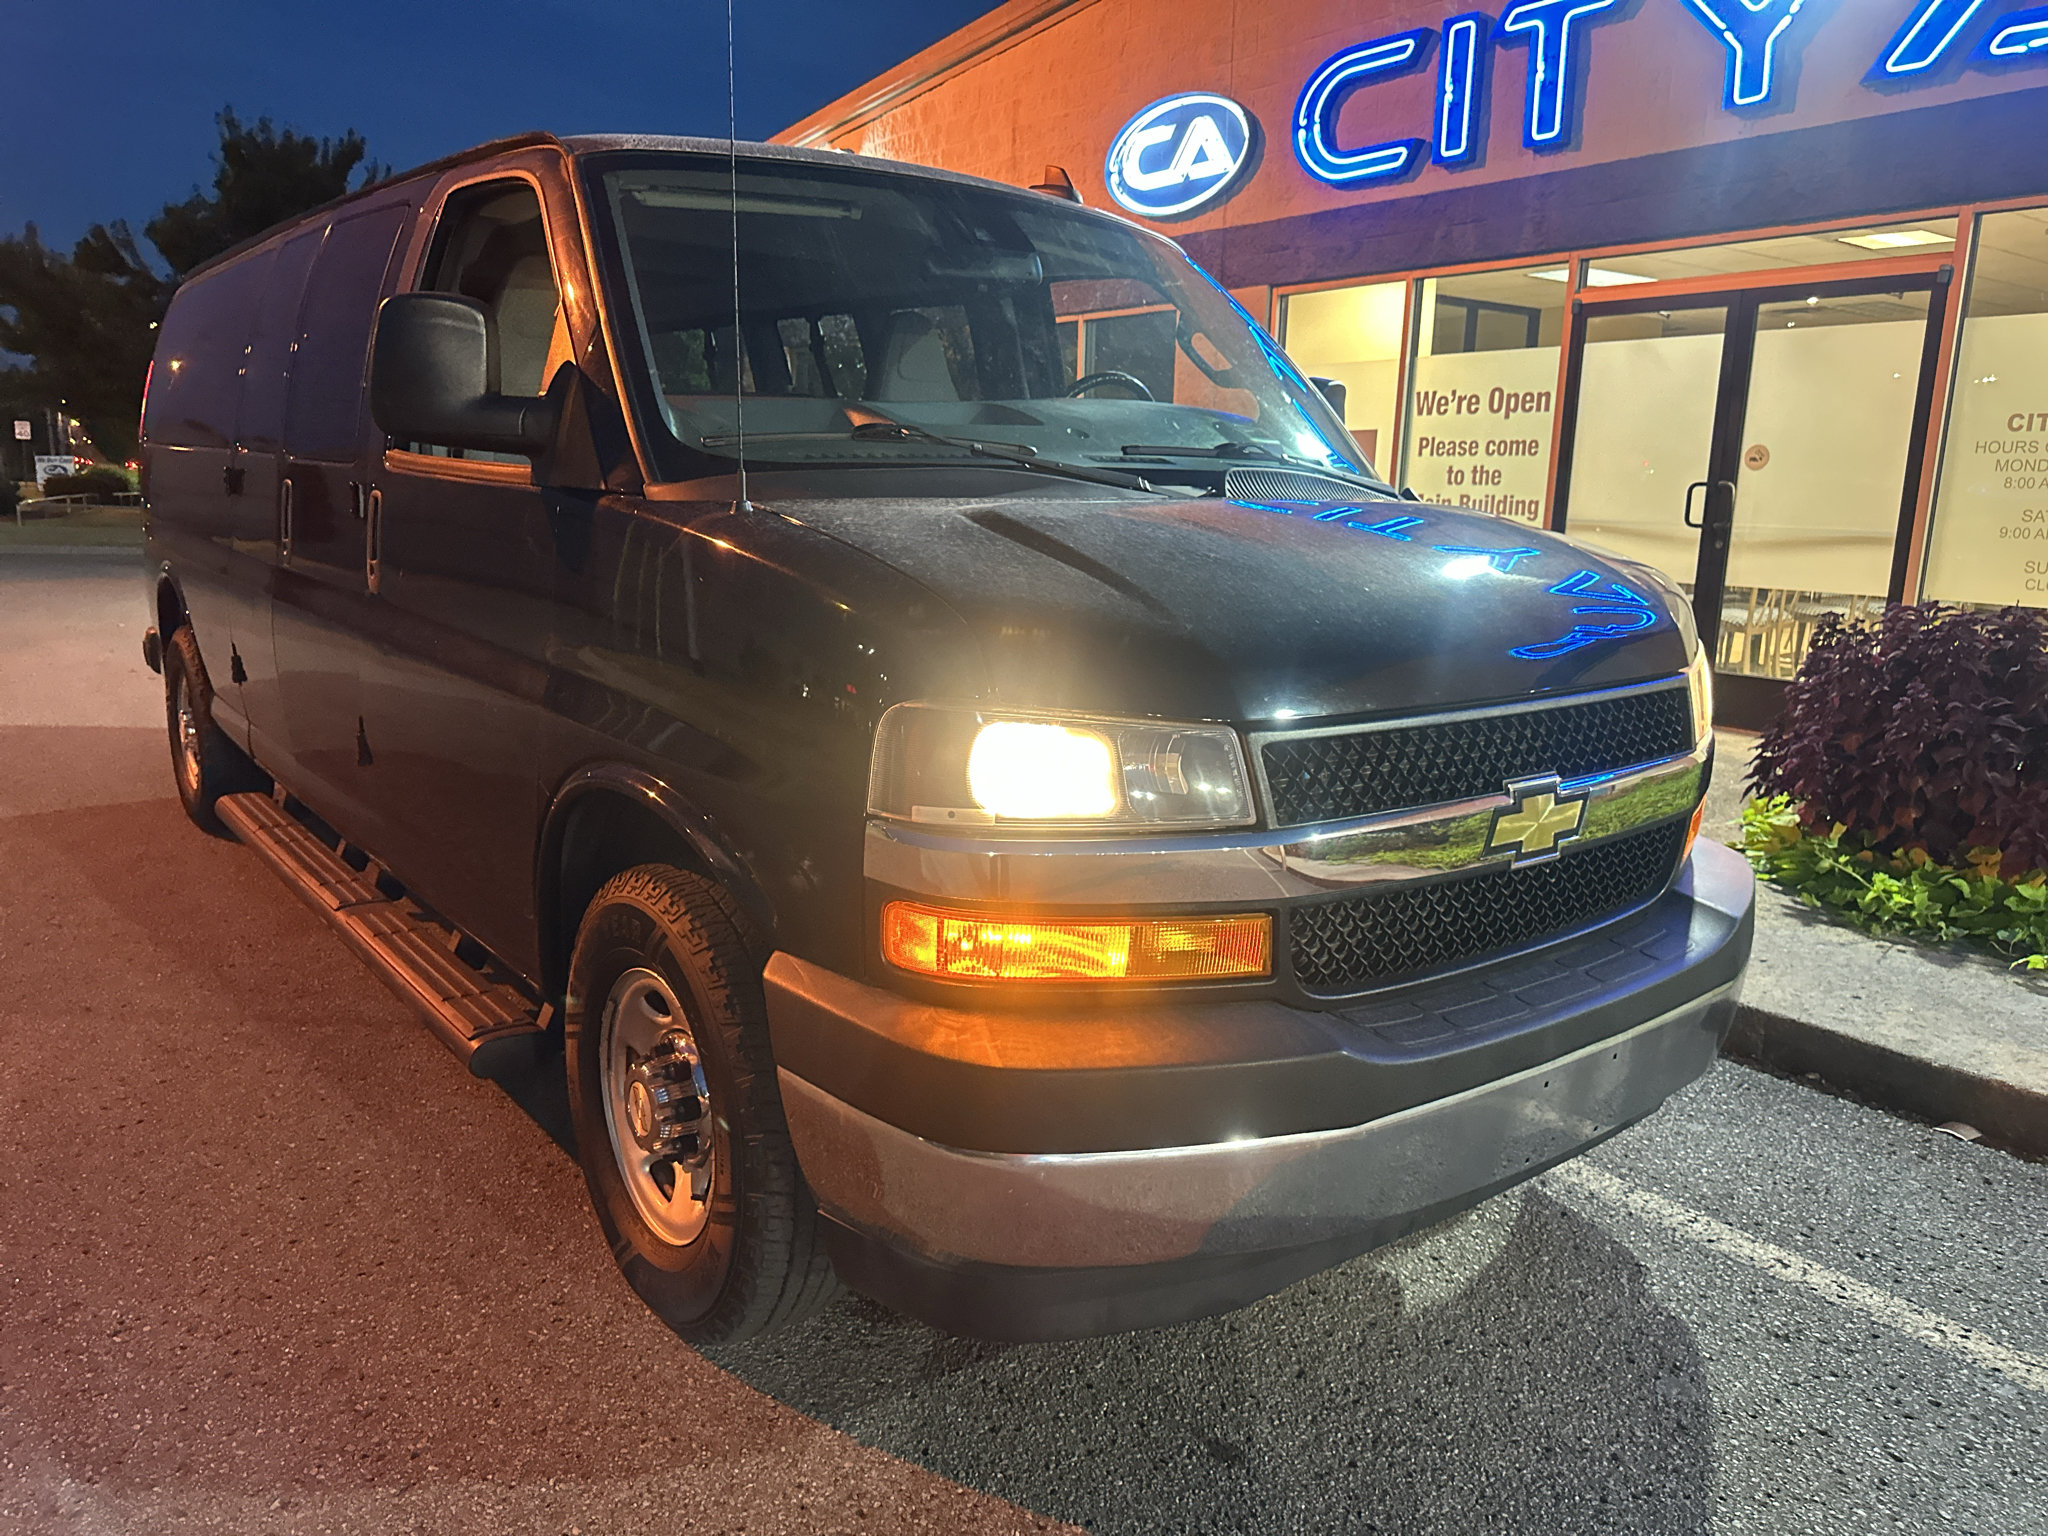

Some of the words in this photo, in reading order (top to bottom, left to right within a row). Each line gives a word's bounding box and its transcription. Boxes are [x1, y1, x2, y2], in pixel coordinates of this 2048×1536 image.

[1122, 114, 1236, 192] CA
[1416, 389, 1480, 417] We're
[1488, 386, 1551, 420] Open
[1418, 436, 1479, 457] Please
[1485, 439, 1539, 456] come
[1975, 440, 2039, 454] HOURS
[1446, 465, 1465, 486] to
[1471, 465, 1502, 486] the
[2004, 477, 2035, 489] 8:00
[1459, 494, 1540, 521] Building
[2021, 509, 2048, 523] SA
[2000, 526, 2031, 540] 9:00
[2033, 527, 2048, 540] A
[2025, 578, 2048, 591] CL
